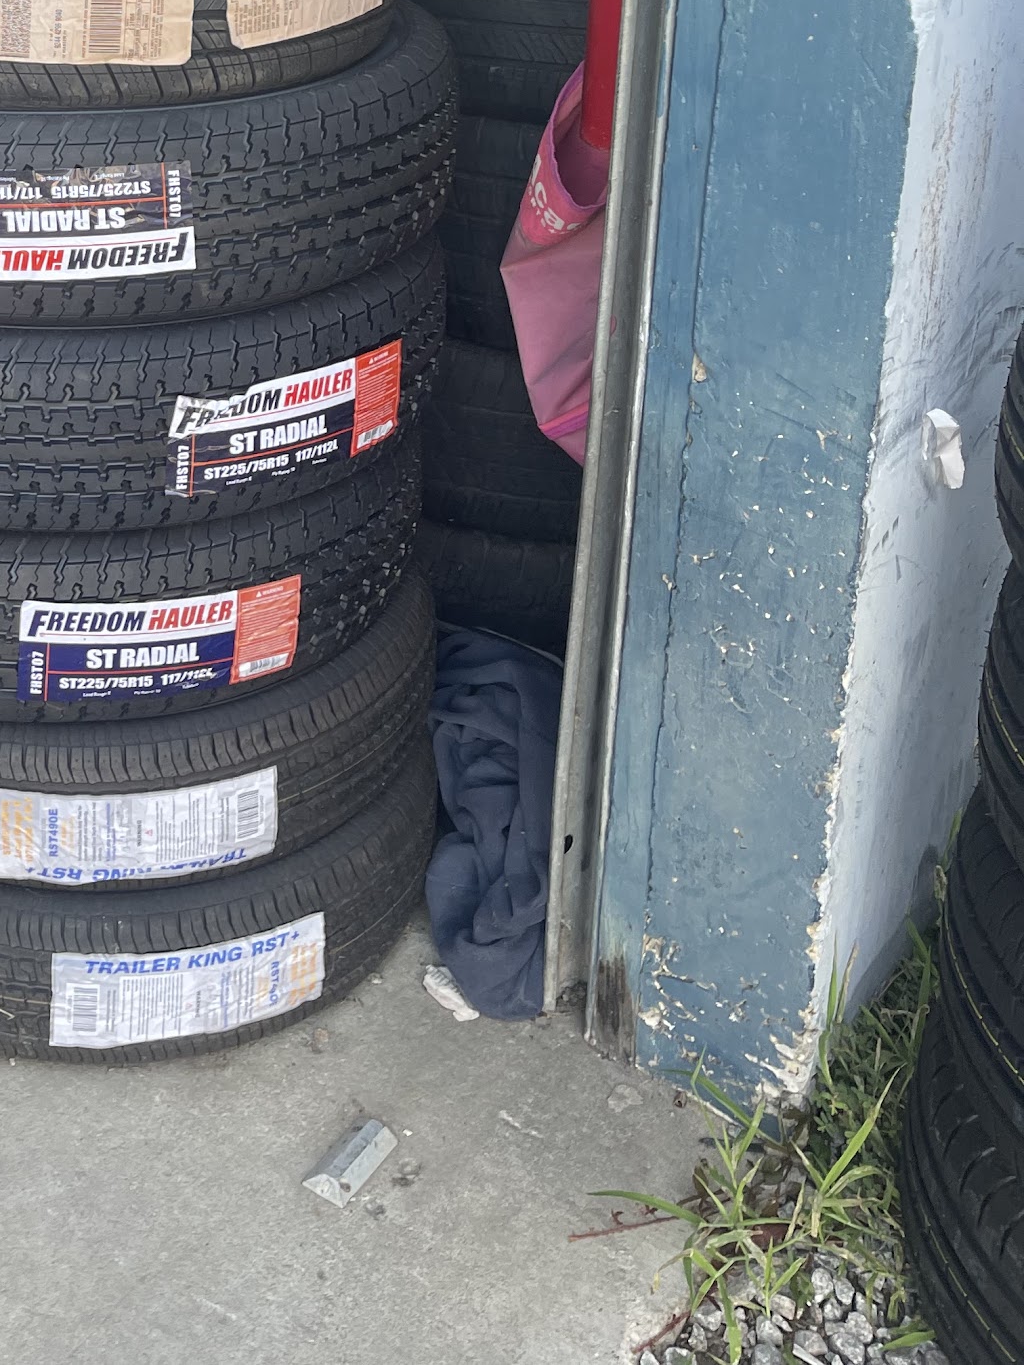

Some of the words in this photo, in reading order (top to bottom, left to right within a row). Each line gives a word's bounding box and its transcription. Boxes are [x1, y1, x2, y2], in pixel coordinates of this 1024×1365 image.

[50, 180, 152, 200] ST225/75R15
[166, 169, 182, 219] FHST07
[5, 209, 93, 233] RADIAL
[94, 207, 126, 231] ST
[68, 231, 189, 273] FREEDOM
[175, 388, 283, 435] FRDOM
[283, 368, 354, 408] HAULER
[229, 427, 258, 455] ST
[260, 414, 328, 449] RADIAL
[175, 445, 191, 491] FHST07
[203, 453, 290, 481] ST225/75R15
[294, 439, 339, 463] 117/112L
[27, 609, 147, 638] FREEDOM
[148, 599, 234, 631] HAULER
[29, 650, 45, 695] FHST07
[86, 648, 118, 670] ST
[120, 641, 200, 668] RADIAL
[59, 675, 154, 690] ST225/75R15
[48, 808, 59, 857] RST490E
[24, 865, 83, 881] RST+
[85, 958, 181, 975] TRAILER
[187, 947, 244, 969] KING
[251, 930, 300, 959] RST+
